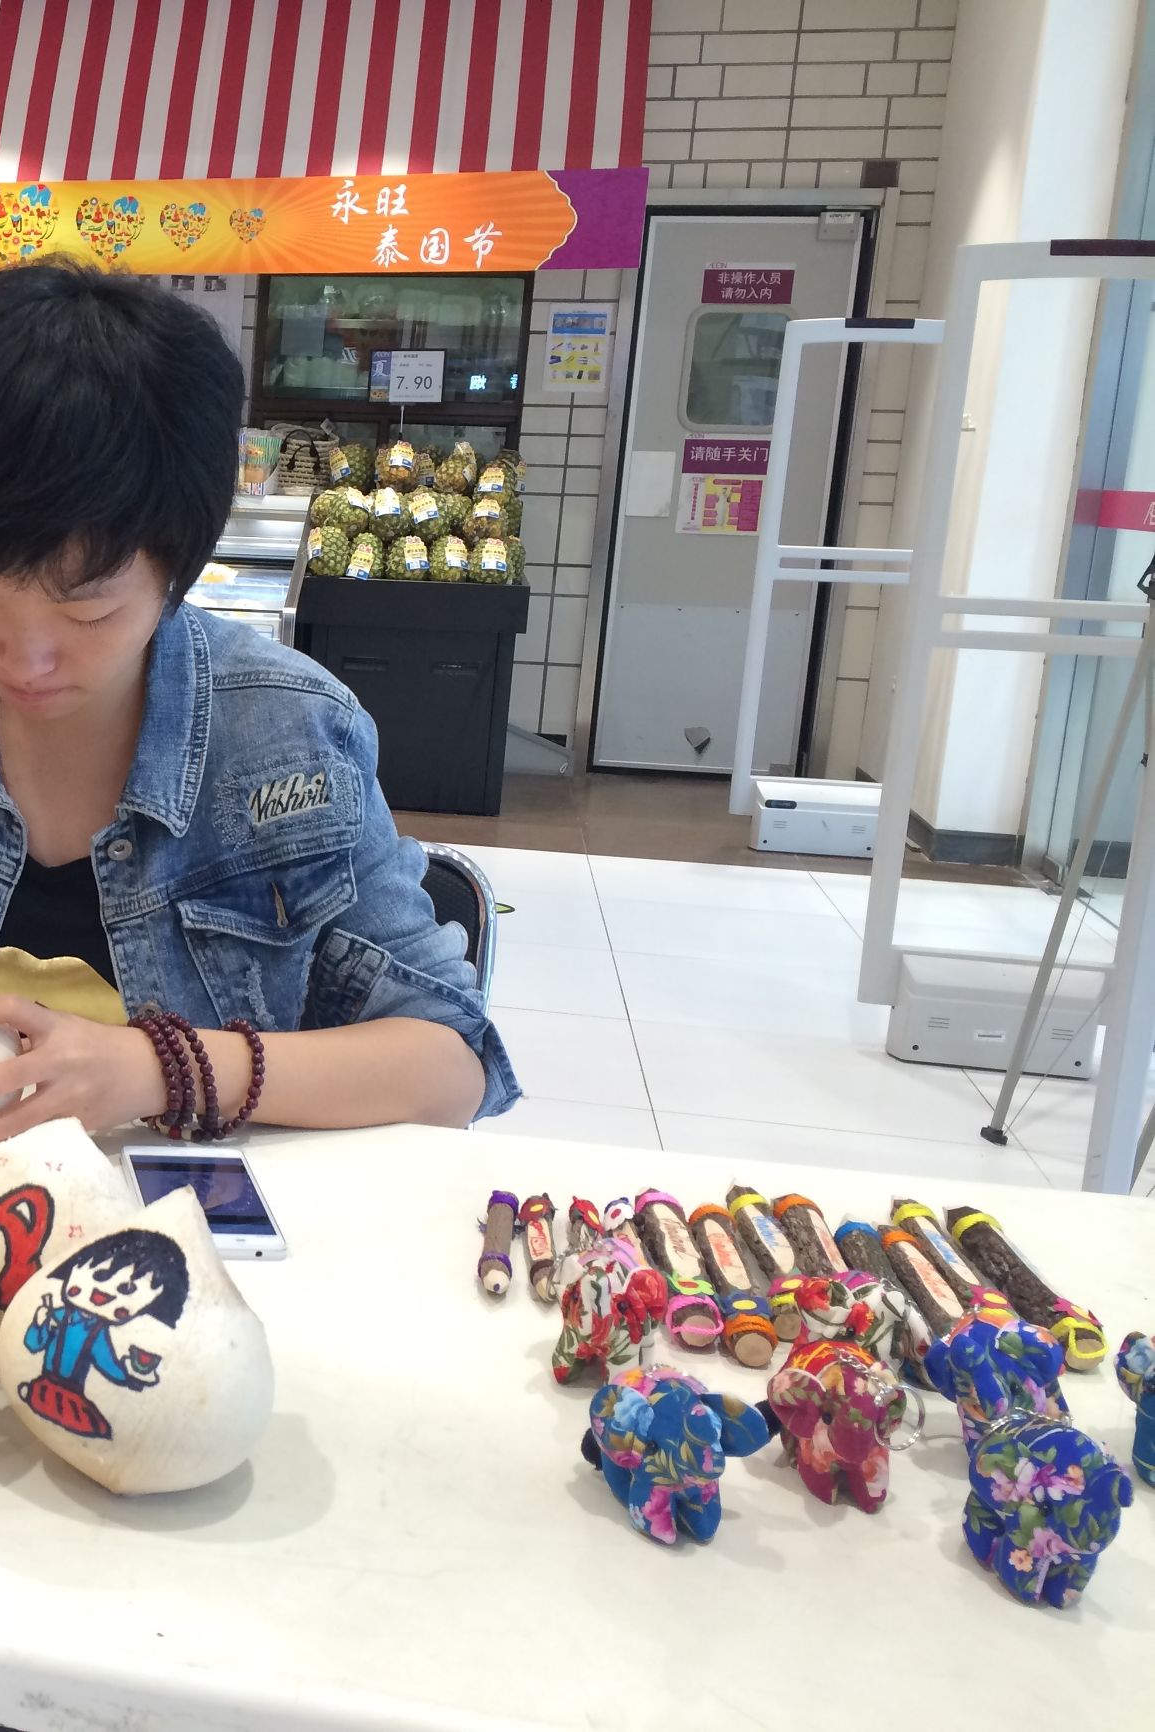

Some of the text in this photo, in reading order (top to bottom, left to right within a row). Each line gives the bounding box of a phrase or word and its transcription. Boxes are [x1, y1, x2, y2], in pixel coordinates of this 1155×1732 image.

[330, 179, 410, 225] 永旺
[371, 223, 503, 269] 泰国节
[718, 272, 781, 285] 非操作人员
[721, 287, 772, 300] 请勿入内
[690, 446, 769, 462] 请随手关门
